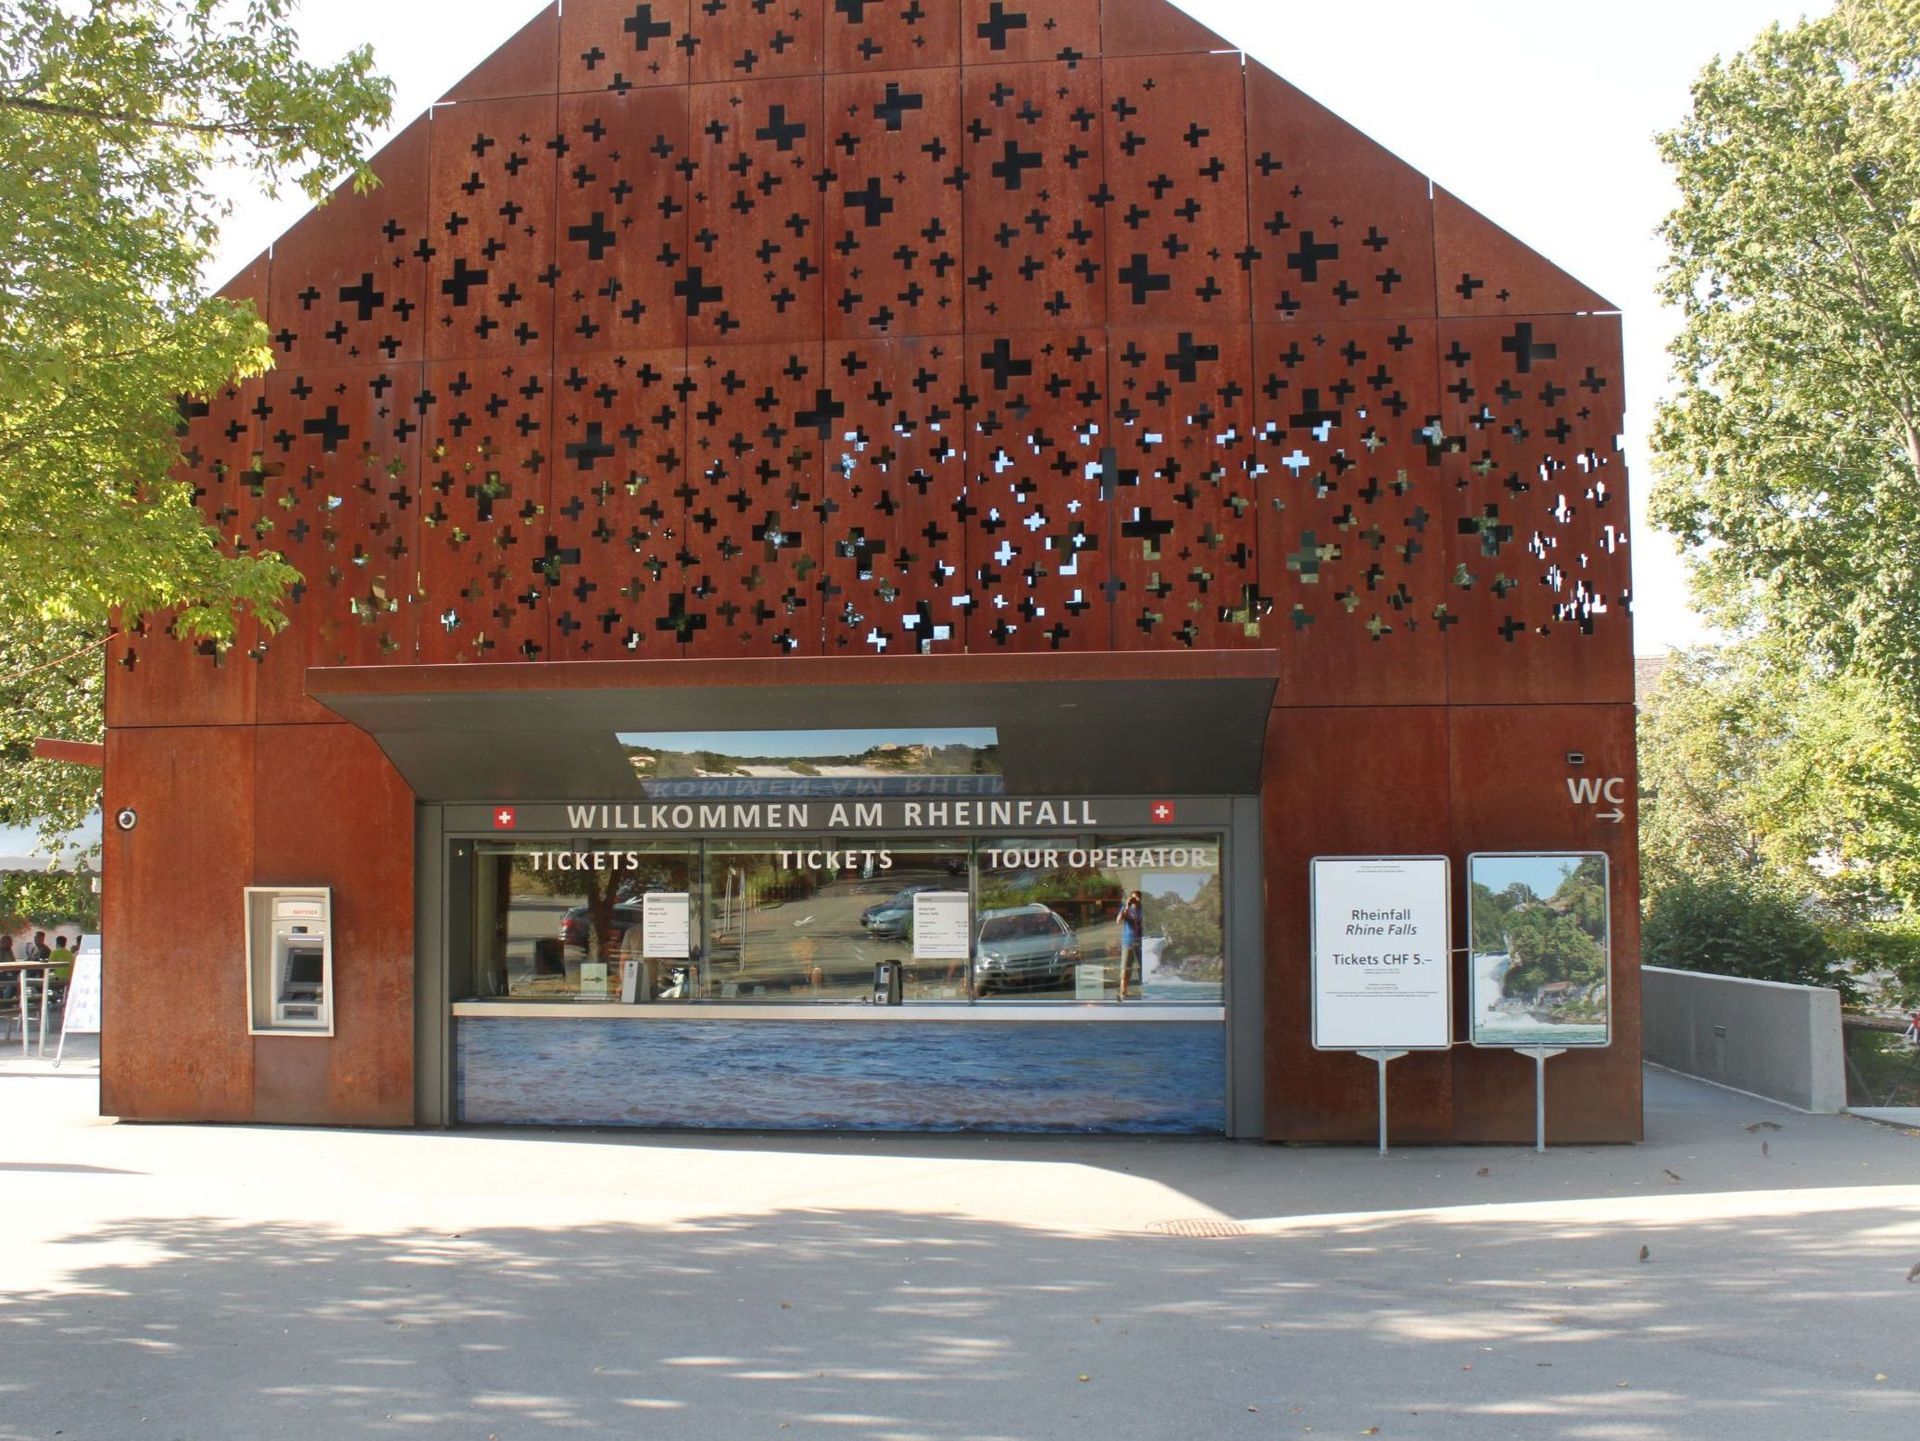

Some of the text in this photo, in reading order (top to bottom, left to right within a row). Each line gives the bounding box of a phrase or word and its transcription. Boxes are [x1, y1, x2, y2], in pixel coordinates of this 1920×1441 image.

[1566, 777, 1625, 804] WC
[567, 800, 1097, 829] WILLKOMMEN AM RHEINFALL
[530, 850, 639, 870] TICKETS
[778, 849, 893, 870] TICKETS
[988, 847, 1206, 869] TOUR OPERATOR
[1351, 909, 1411, 920] Rheinfall
[1345, 924, 1418, 935] Rhine Falls
[1332, 953, 1379, 965] Tickets
[1383, 954, 1409, 965] CHF
